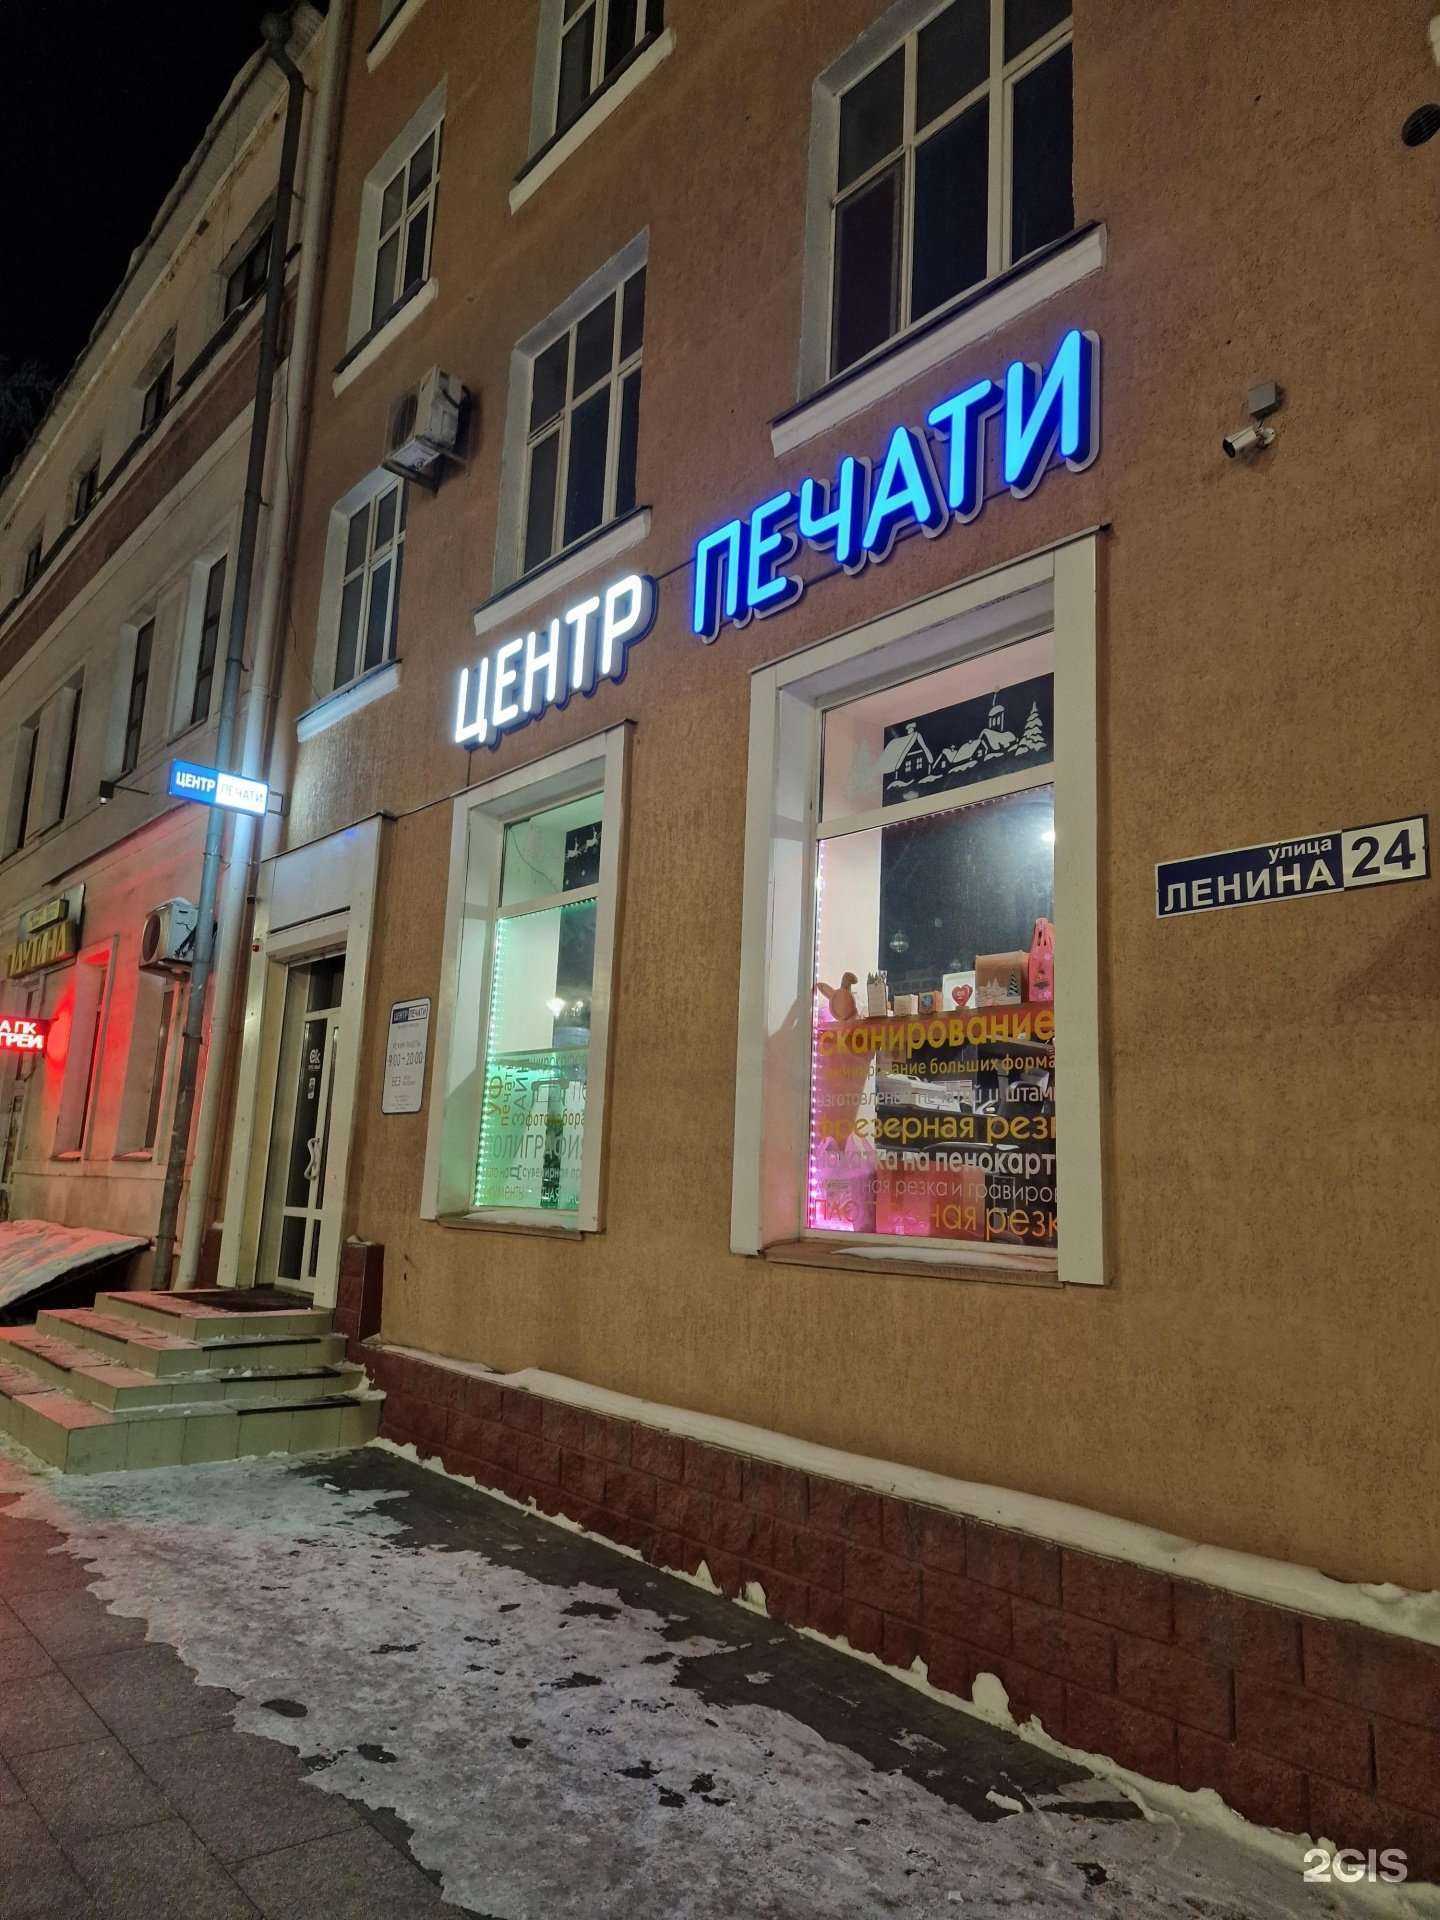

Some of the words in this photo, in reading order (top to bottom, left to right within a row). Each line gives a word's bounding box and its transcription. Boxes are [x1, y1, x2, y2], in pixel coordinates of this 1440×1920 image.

[453, 573, 652, 747] ЦЕНТР
[692, 328, 1096, 640] ПЕЧАТИ
[175, 771, 216, 792] ЦЕНТР
[220, 783, 263, 802] ПЕЧАТИ
[1268, 838, 1332, 864] улица
[1164, 858, 1336, 912] ЛЕНИНА
[1351, 828, 1416, 878] 24
[819, 1009, 1056, 1058] сканирование
[930, 1057, 998, 1075] больших
[936, 1151, 1056, 1177] пенокарт
[896, 1180, 948, 1201] резка
